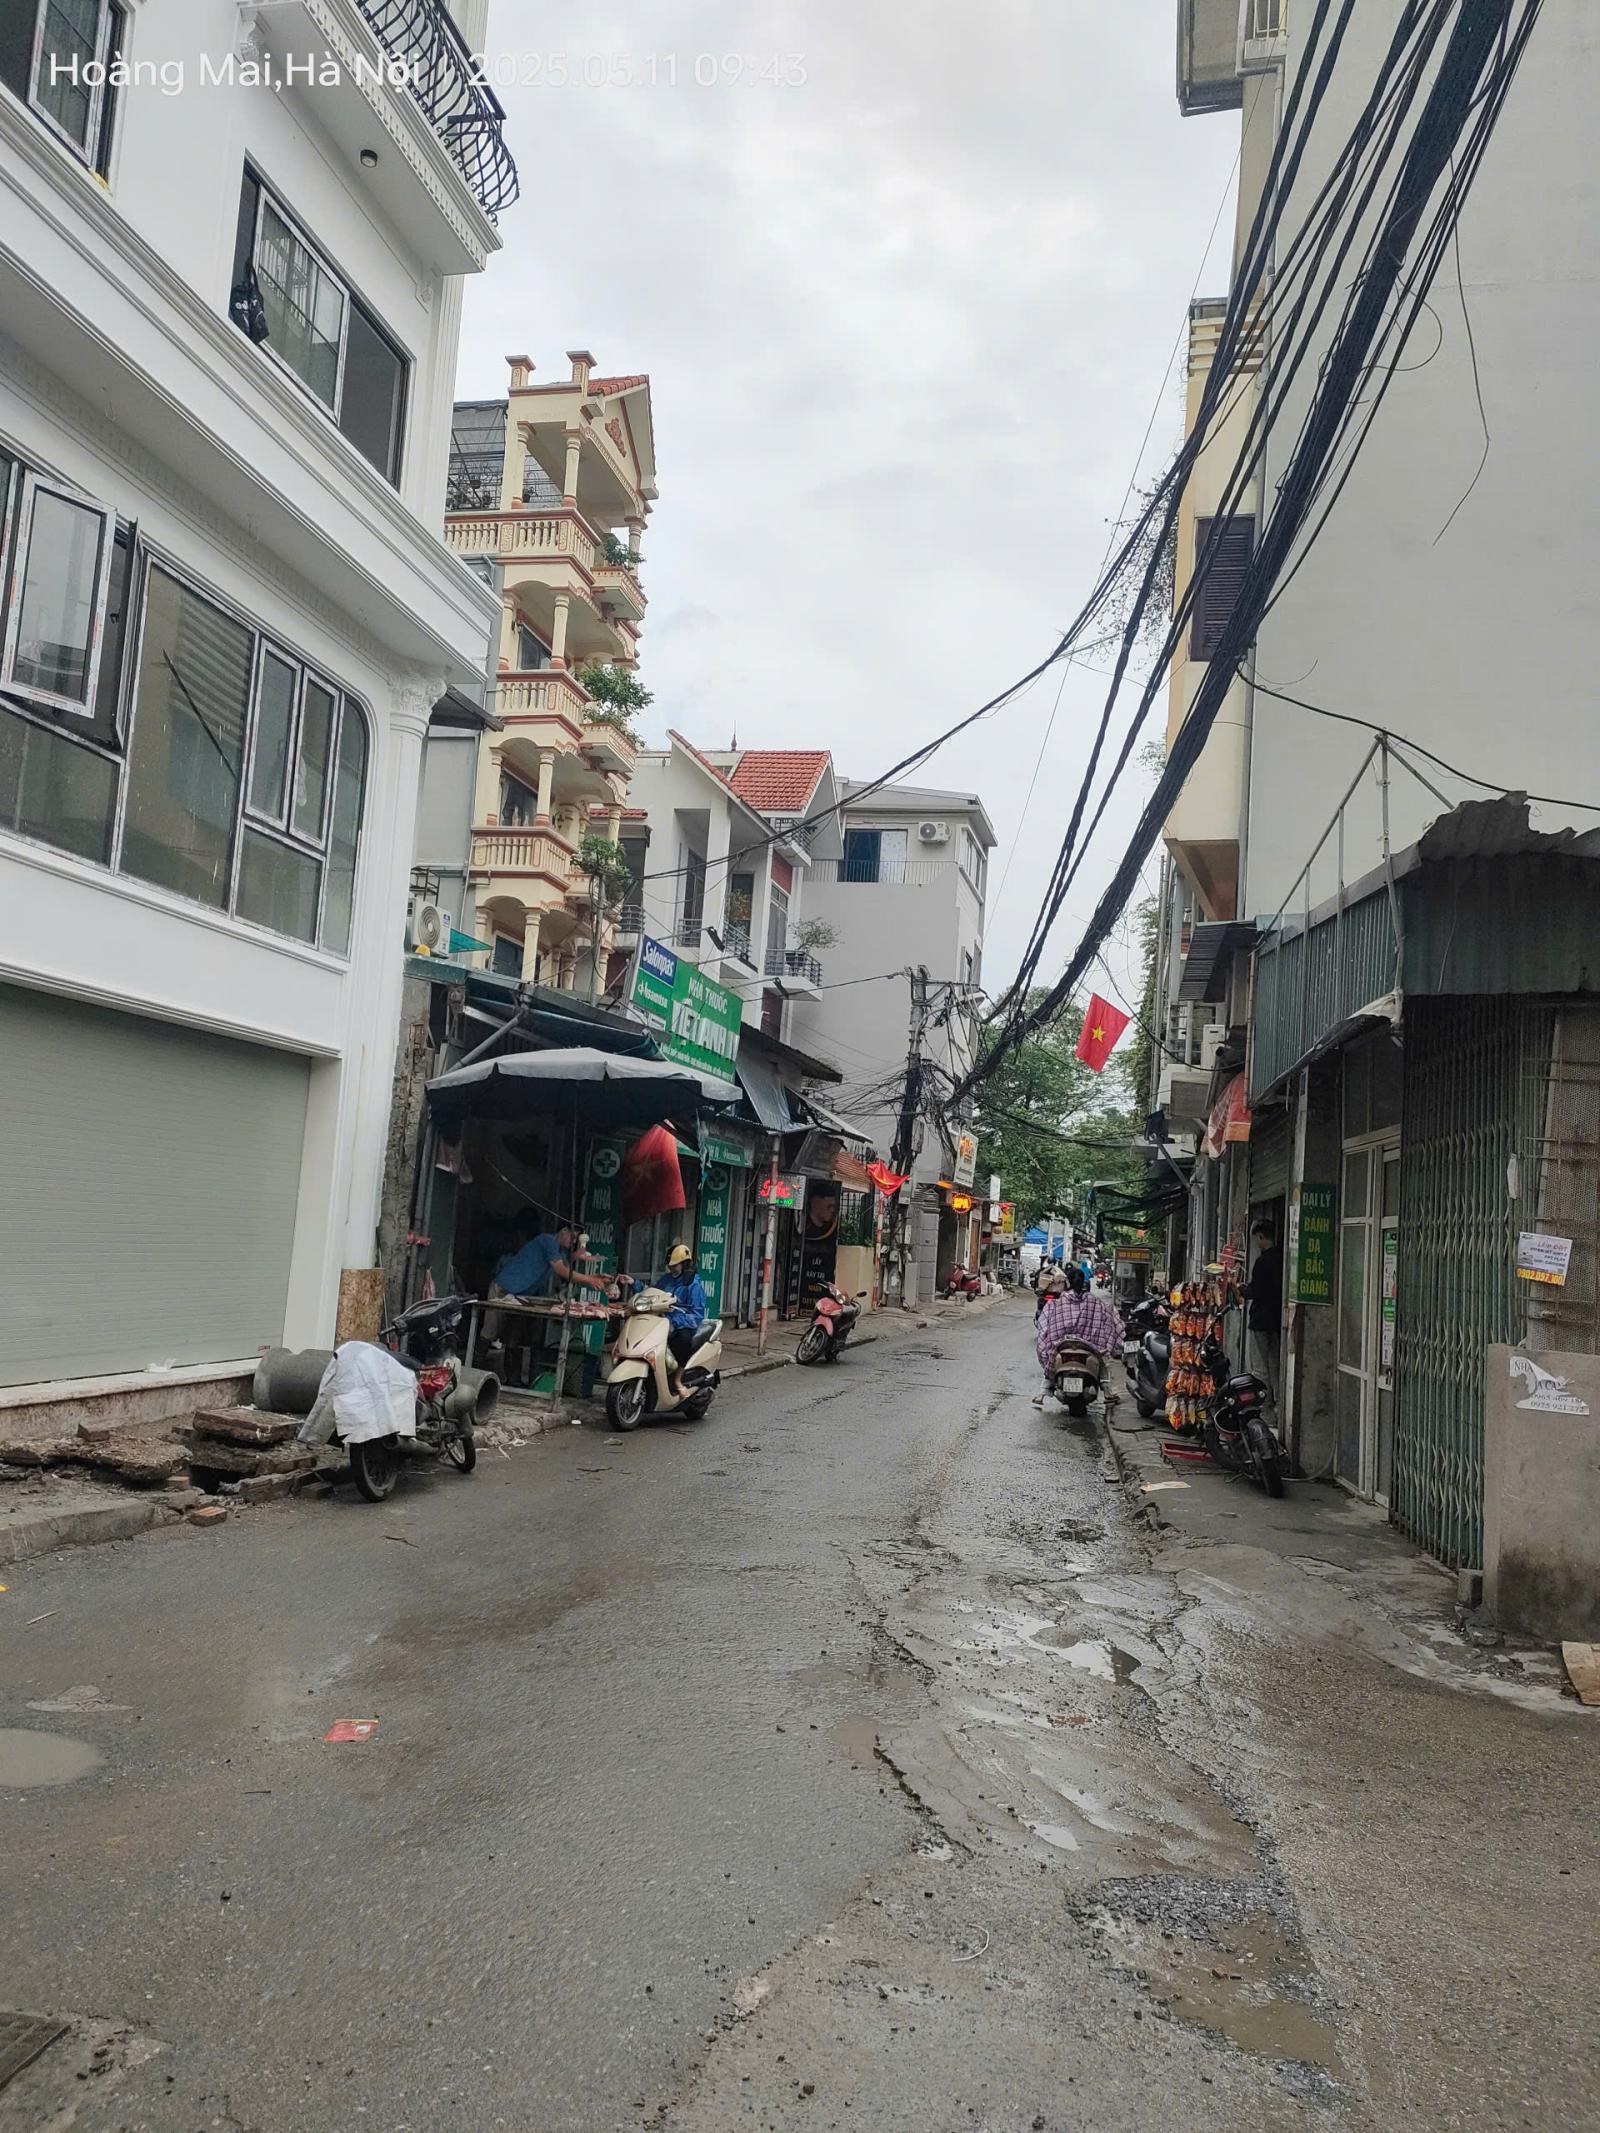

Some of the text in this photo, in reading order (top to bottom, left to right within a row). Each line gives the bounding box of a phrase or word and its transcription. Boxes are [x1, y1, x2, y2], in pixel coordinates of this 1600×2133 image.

[643, 941, 674, 977] Salonpas
[688, 977, 727, 1014] NHÀ THUỐC
[699, 1017, 728, 1056] ANH
[593, 1186, 611, 1211] NHÀ
[707, 1196, 722, 1217] NHÀ
[1320, 1190, 1332, 1207] LÝ
[586, 1218, 614, 1244] THUỐC
[701, 1222, 724, 1244] THUỐC
[702, 1253, 718, 1273] VIỆT
[1305, 1254, 1324, 1274] BẮC
[1300, 1279, 1328, 1296] GIANG
